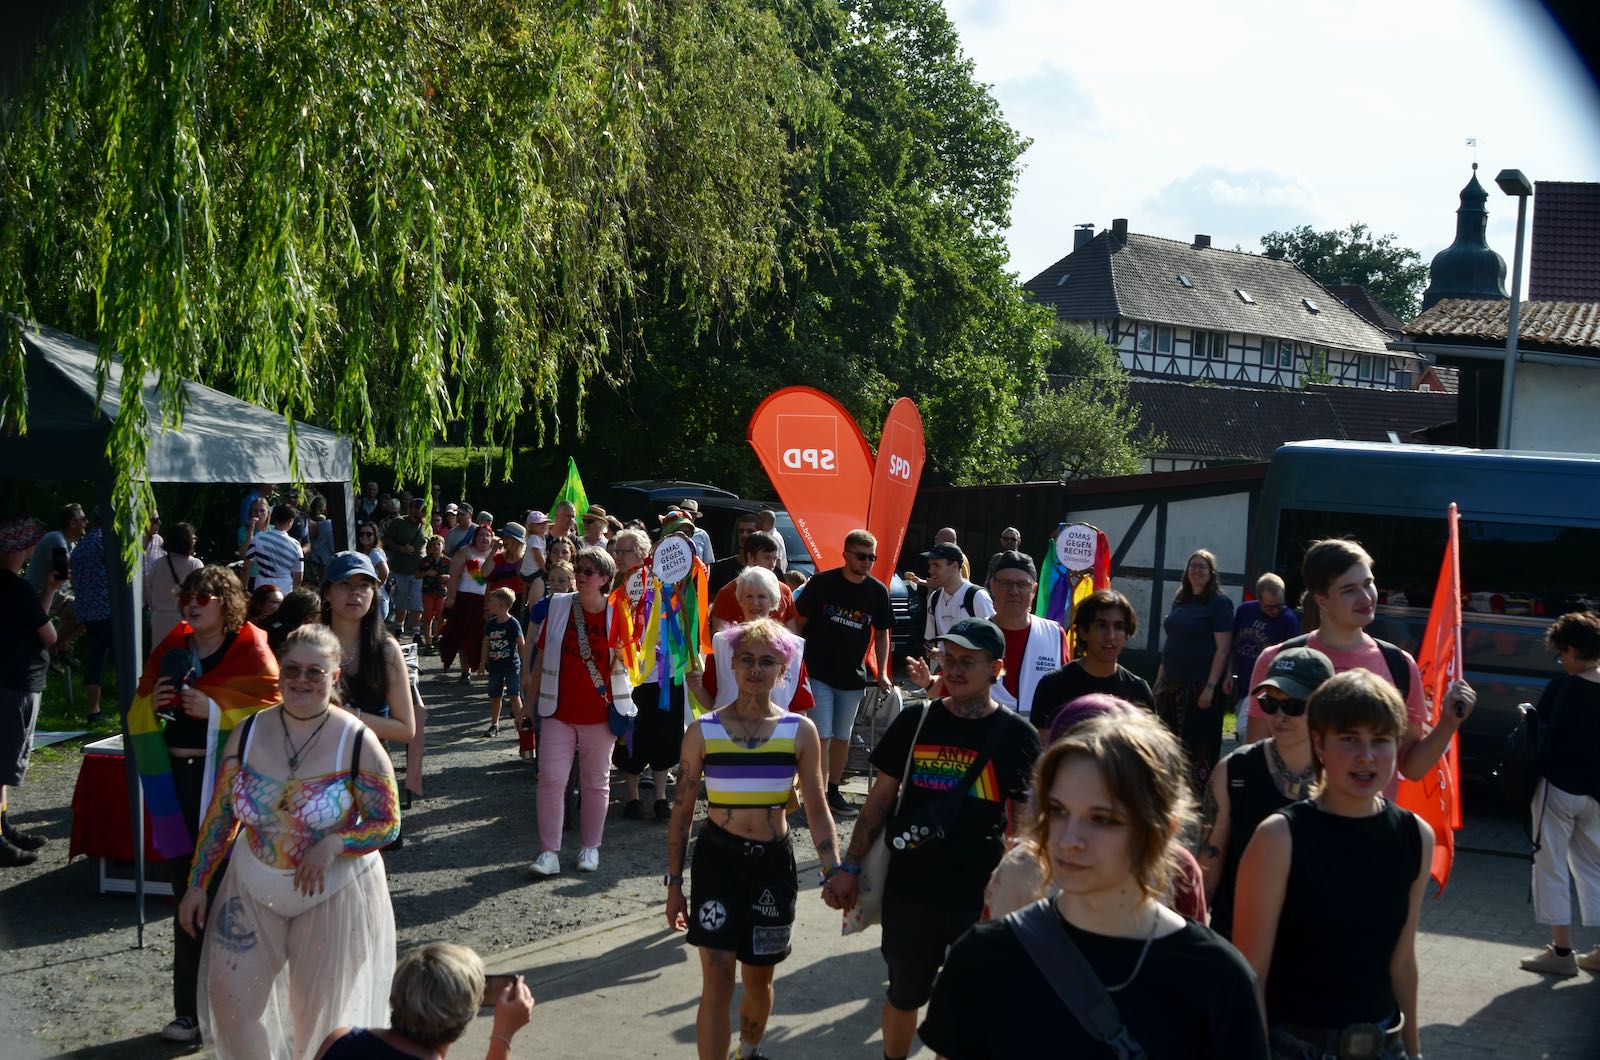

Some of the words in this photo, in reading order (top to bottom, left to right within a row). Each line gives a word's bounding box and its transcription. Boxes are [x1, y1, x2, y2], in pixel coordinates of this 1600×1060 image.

[889, 454, 911, 480] SPD
[1068, 531, 1091, 541] OMAS
[660, 542, 680, 556] OMAS
[1065, 539, 1092, 549] GEGEN
[660, 549, 684, 564] GEGEN
[1063, 547, 1092, 557] RECHTS
[661, 556, 687, 572] RECHTS
[1035, 660, 1056, 668] GEGEN
[936, 747, 974, 765] ANTI
